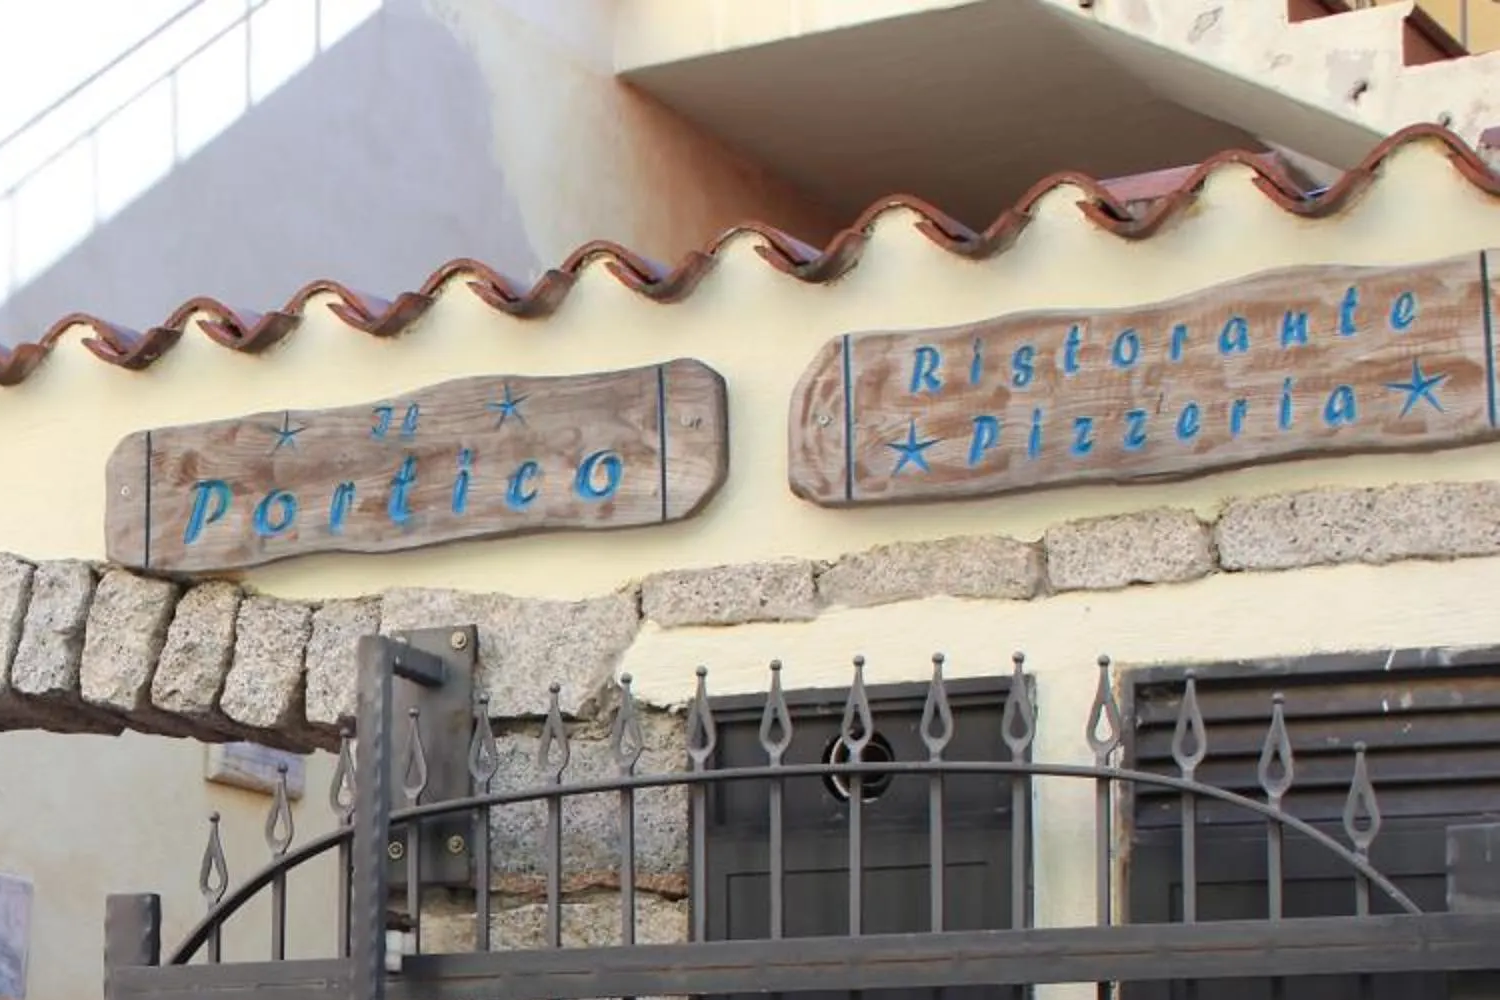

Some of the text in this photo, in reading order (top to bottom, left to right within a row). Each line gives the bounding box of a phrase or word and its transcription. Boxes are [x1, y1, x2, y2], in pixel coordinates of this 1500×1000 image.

[908, 285, 1417, 396] Ristorante
[967, 377, 1358, 467] Pizzeria
[183, 447, 625, 546] Portico
